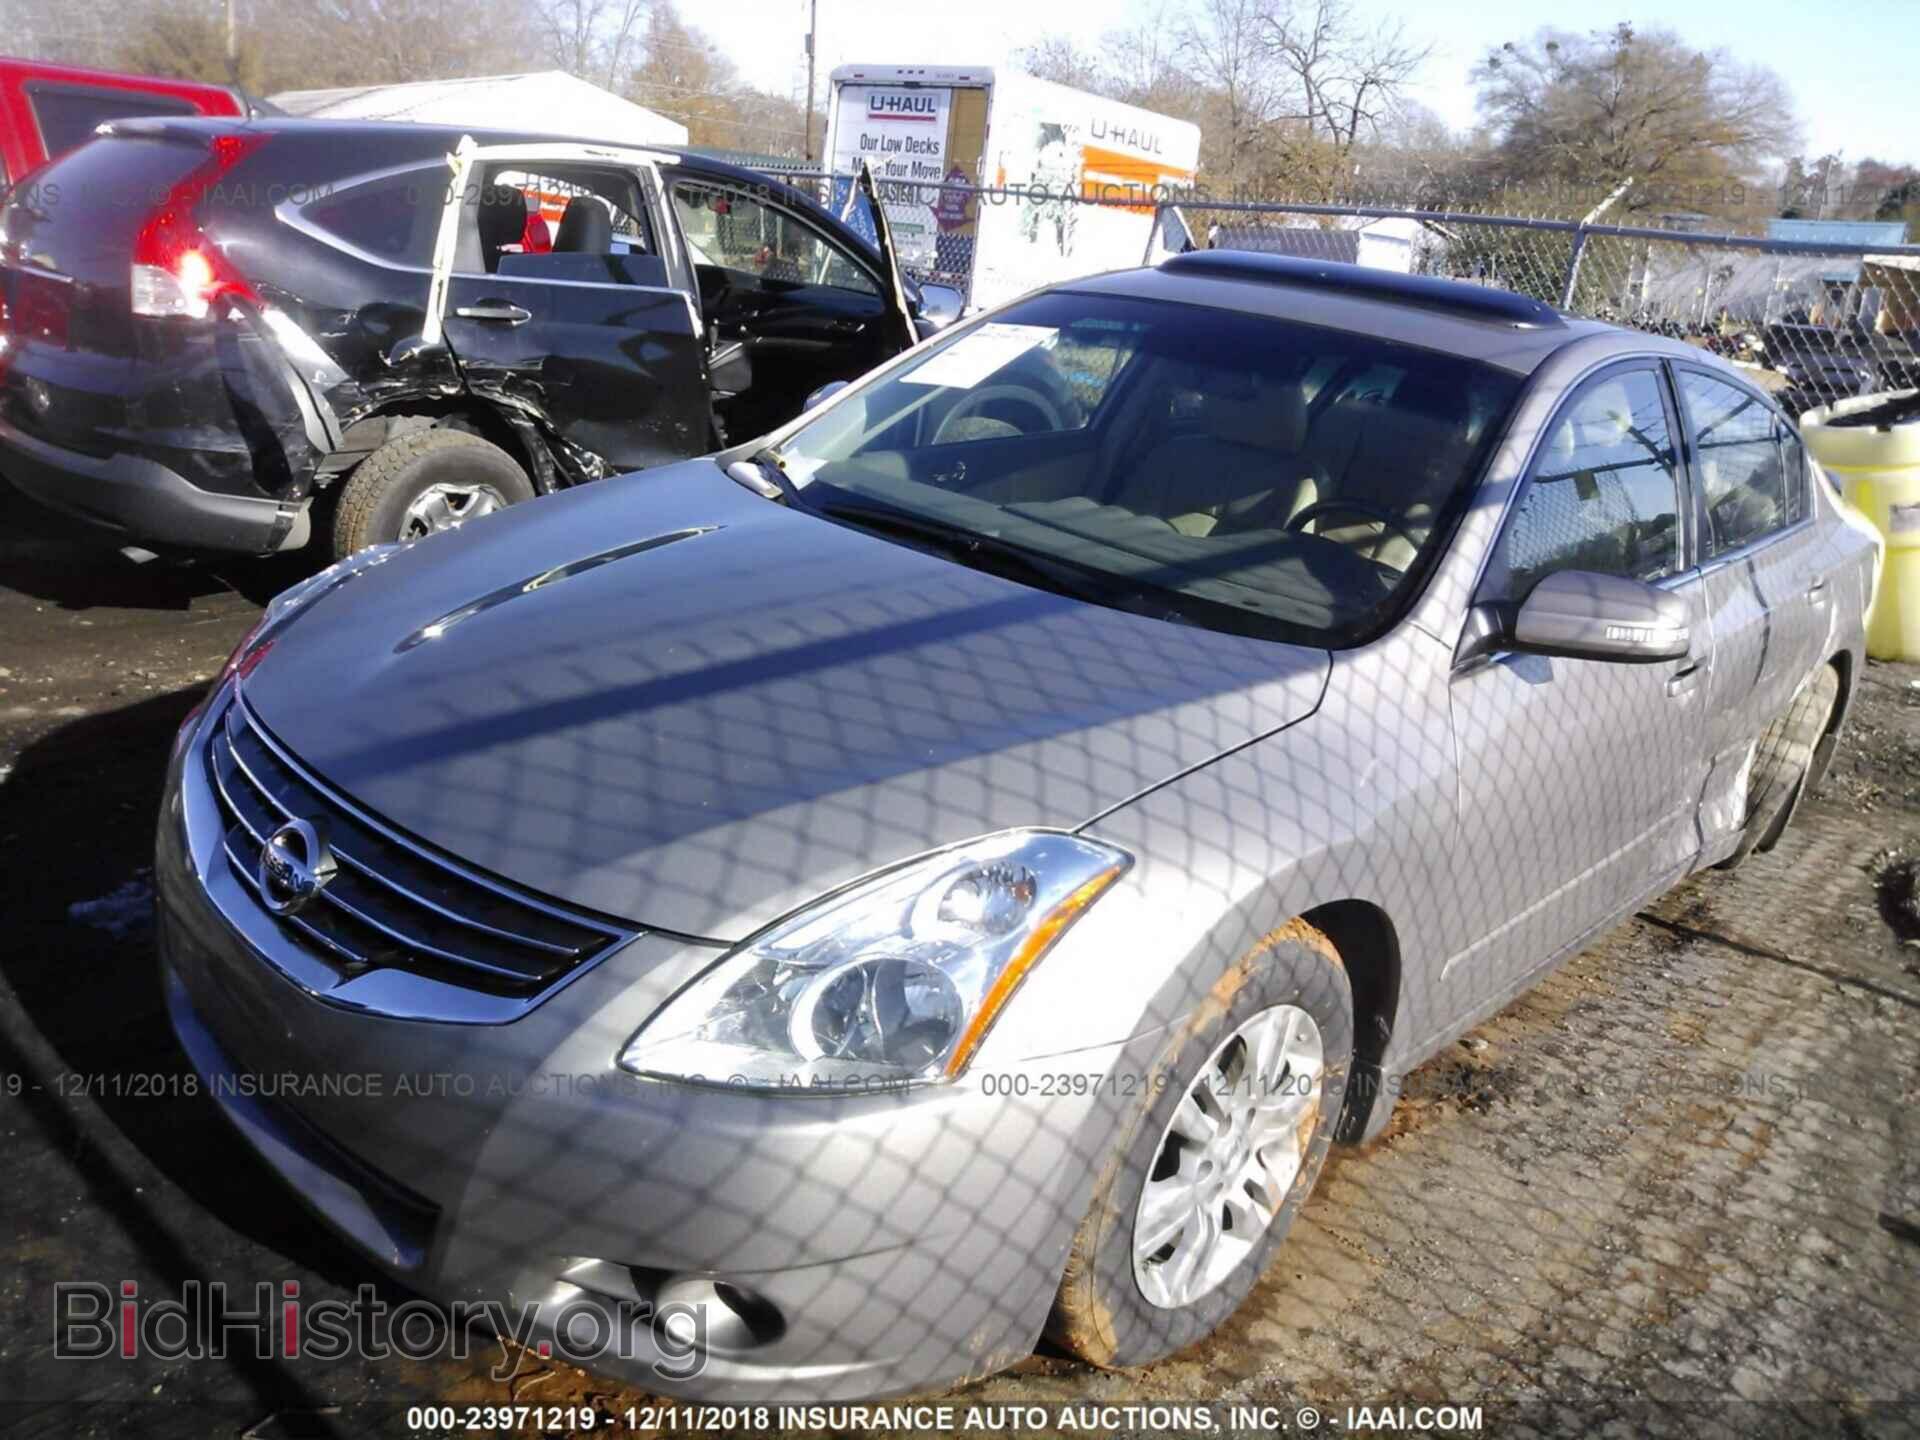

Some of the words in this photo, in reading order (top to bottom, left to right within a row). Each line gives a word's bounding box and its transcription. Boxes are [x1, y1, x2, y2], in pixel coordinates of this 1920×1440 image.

[870, 95, 936, 113] U-HAUL
[860, 133, 878, 151] Our
[881, 135, 903, 153] Low
[905, 136, 940, 154] Decks
[1091, 118, 1163, 154] U-HAUL
[885, 159, 908, 177] Your
[911, 161, 941, 179] Move
